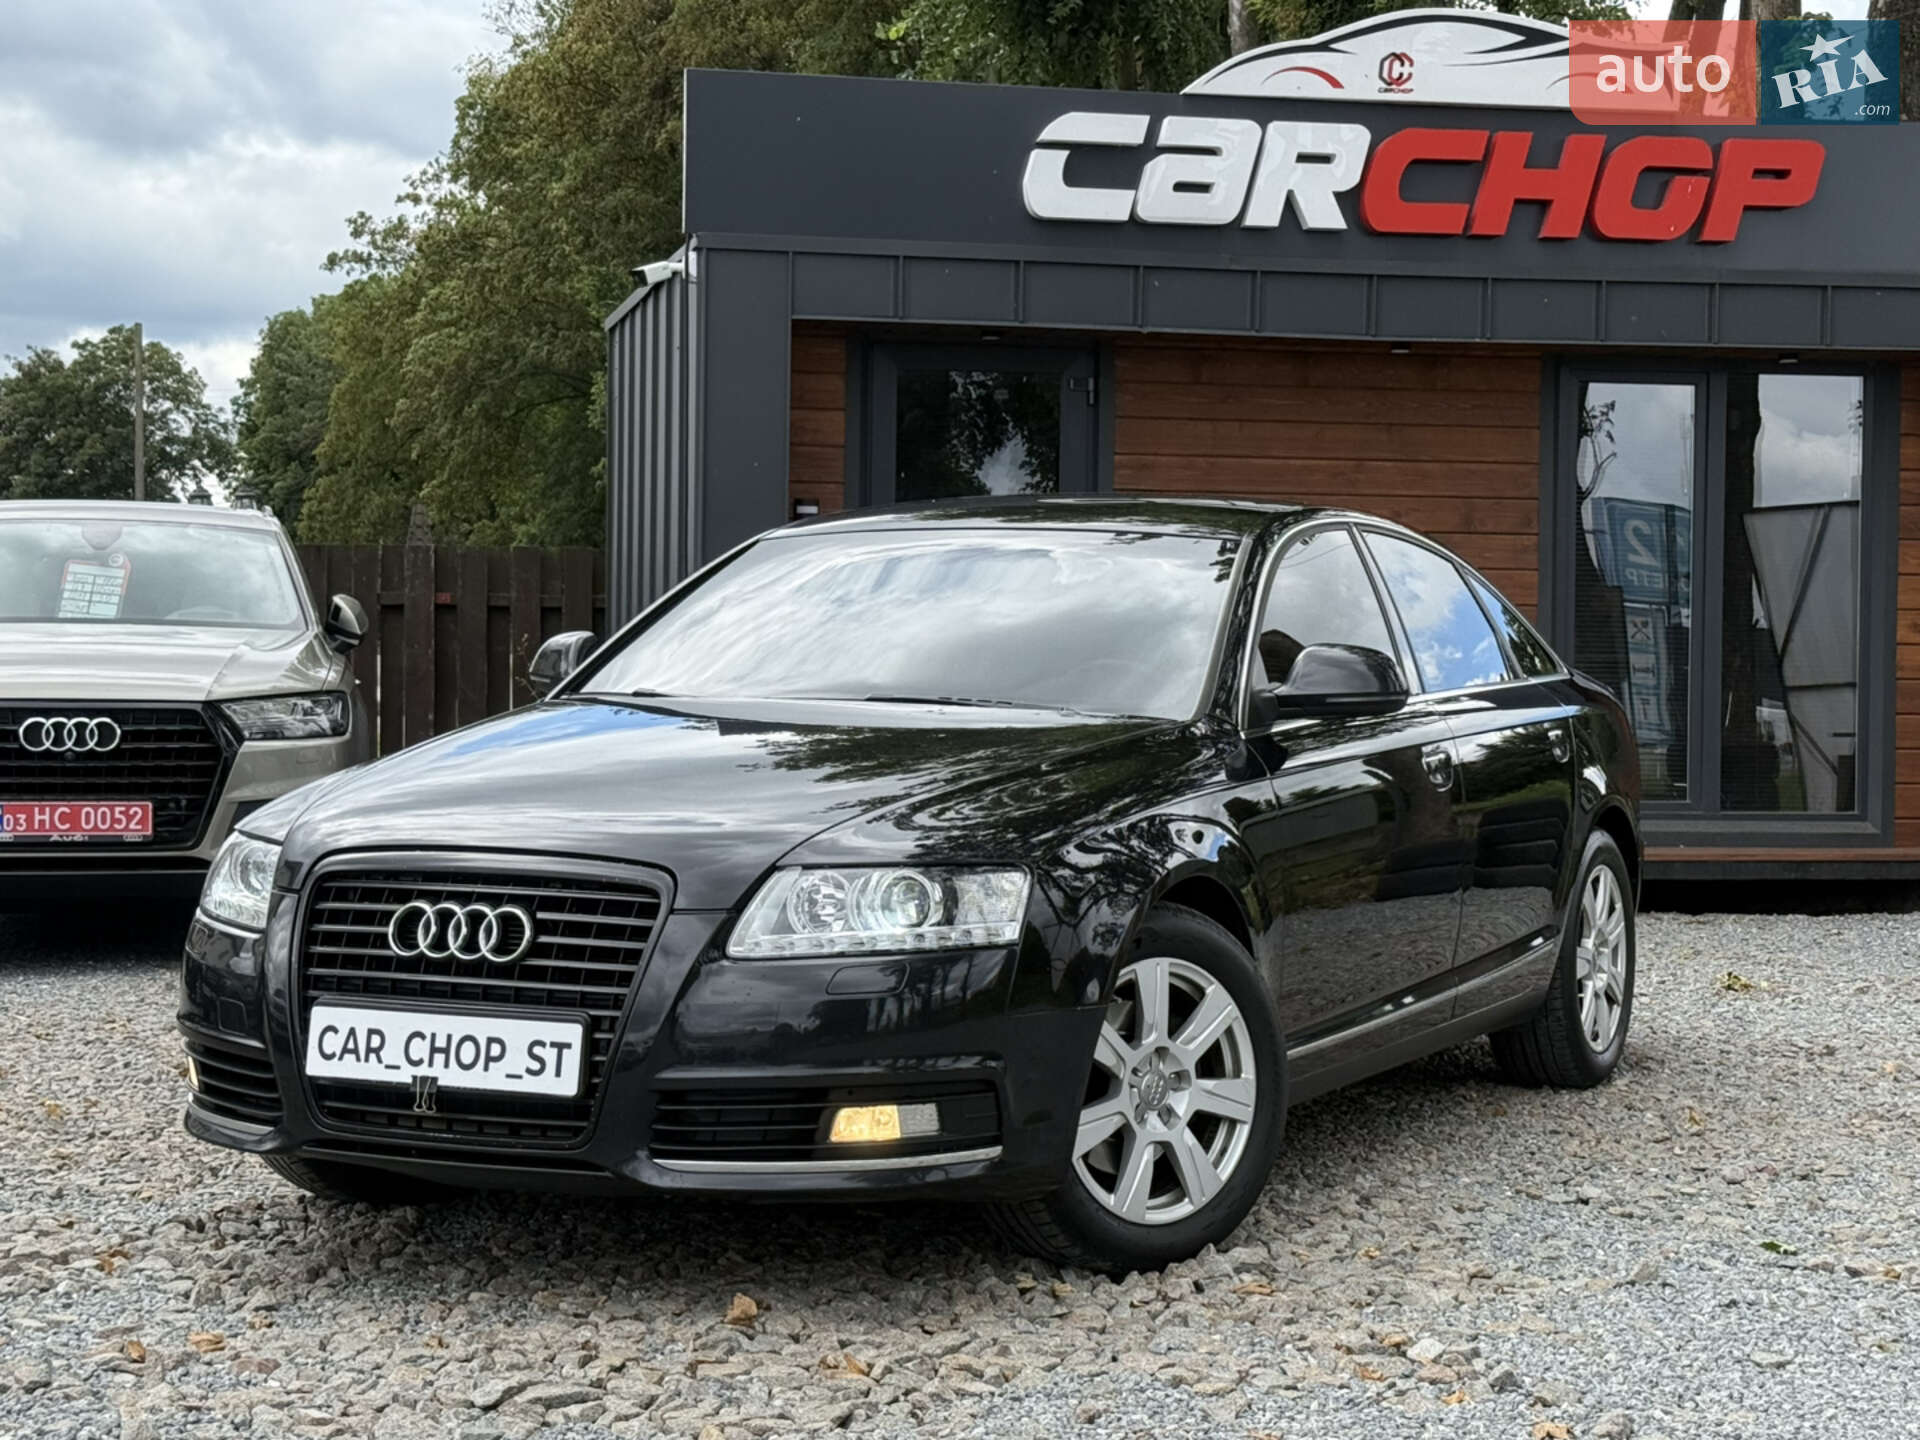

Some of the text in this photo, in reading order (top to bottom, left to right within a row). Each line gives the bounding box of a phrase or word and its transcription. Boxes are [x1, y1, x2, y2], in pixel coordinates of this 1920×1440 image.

[3, 814, 27, 831] 03
[81, 807, 143, 830] 0052
[317, 1024, 573, 1079] CAR_CHOP_ST
